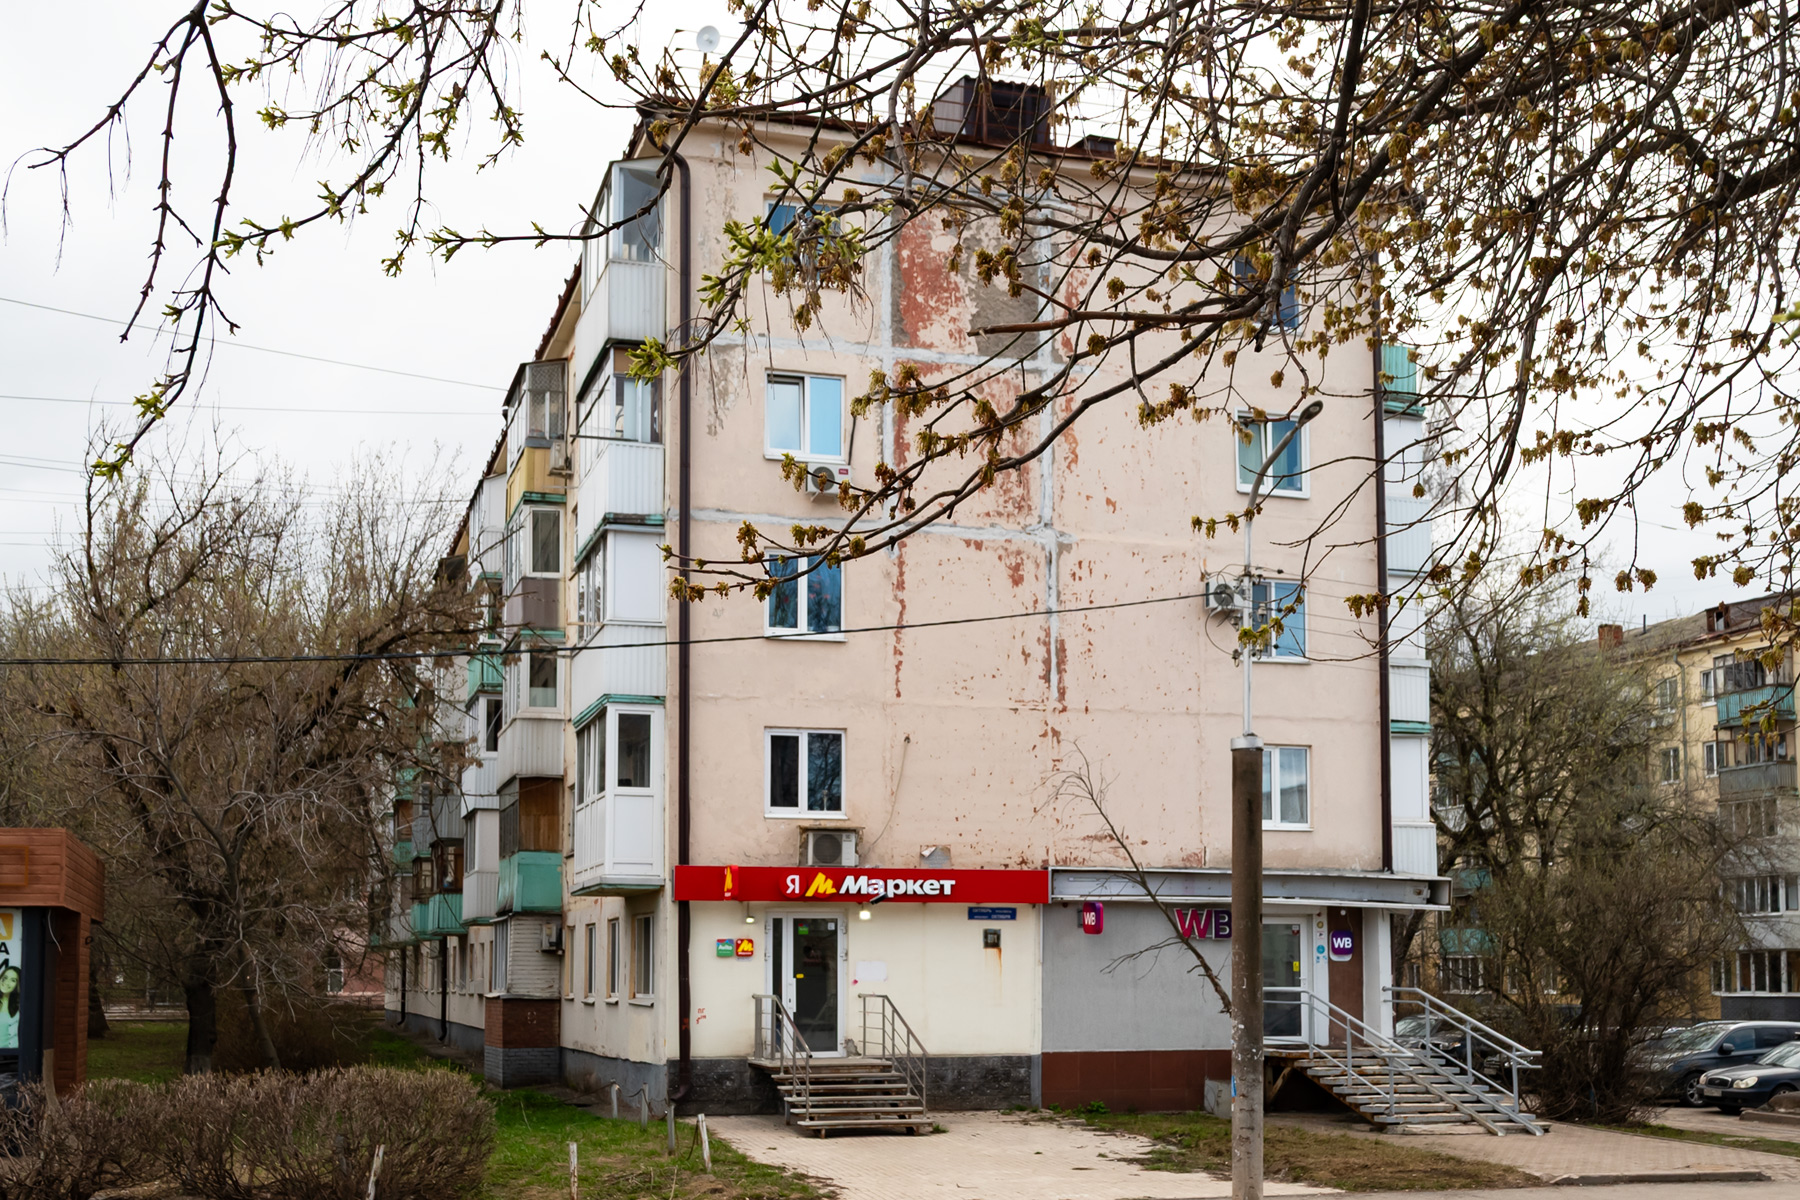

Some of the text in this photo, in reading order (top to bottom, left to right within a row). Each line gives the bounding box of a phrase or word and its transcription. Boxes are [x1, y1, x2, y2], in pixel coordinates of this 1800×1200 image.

[786, 875, 800, 894] Я
[839, 875, 956, 898] Маркет
[1083, 911, 1096, 926] WB
[1173, 908, 1232, 940] WB
[1332, 937, 1353, 949] WB
